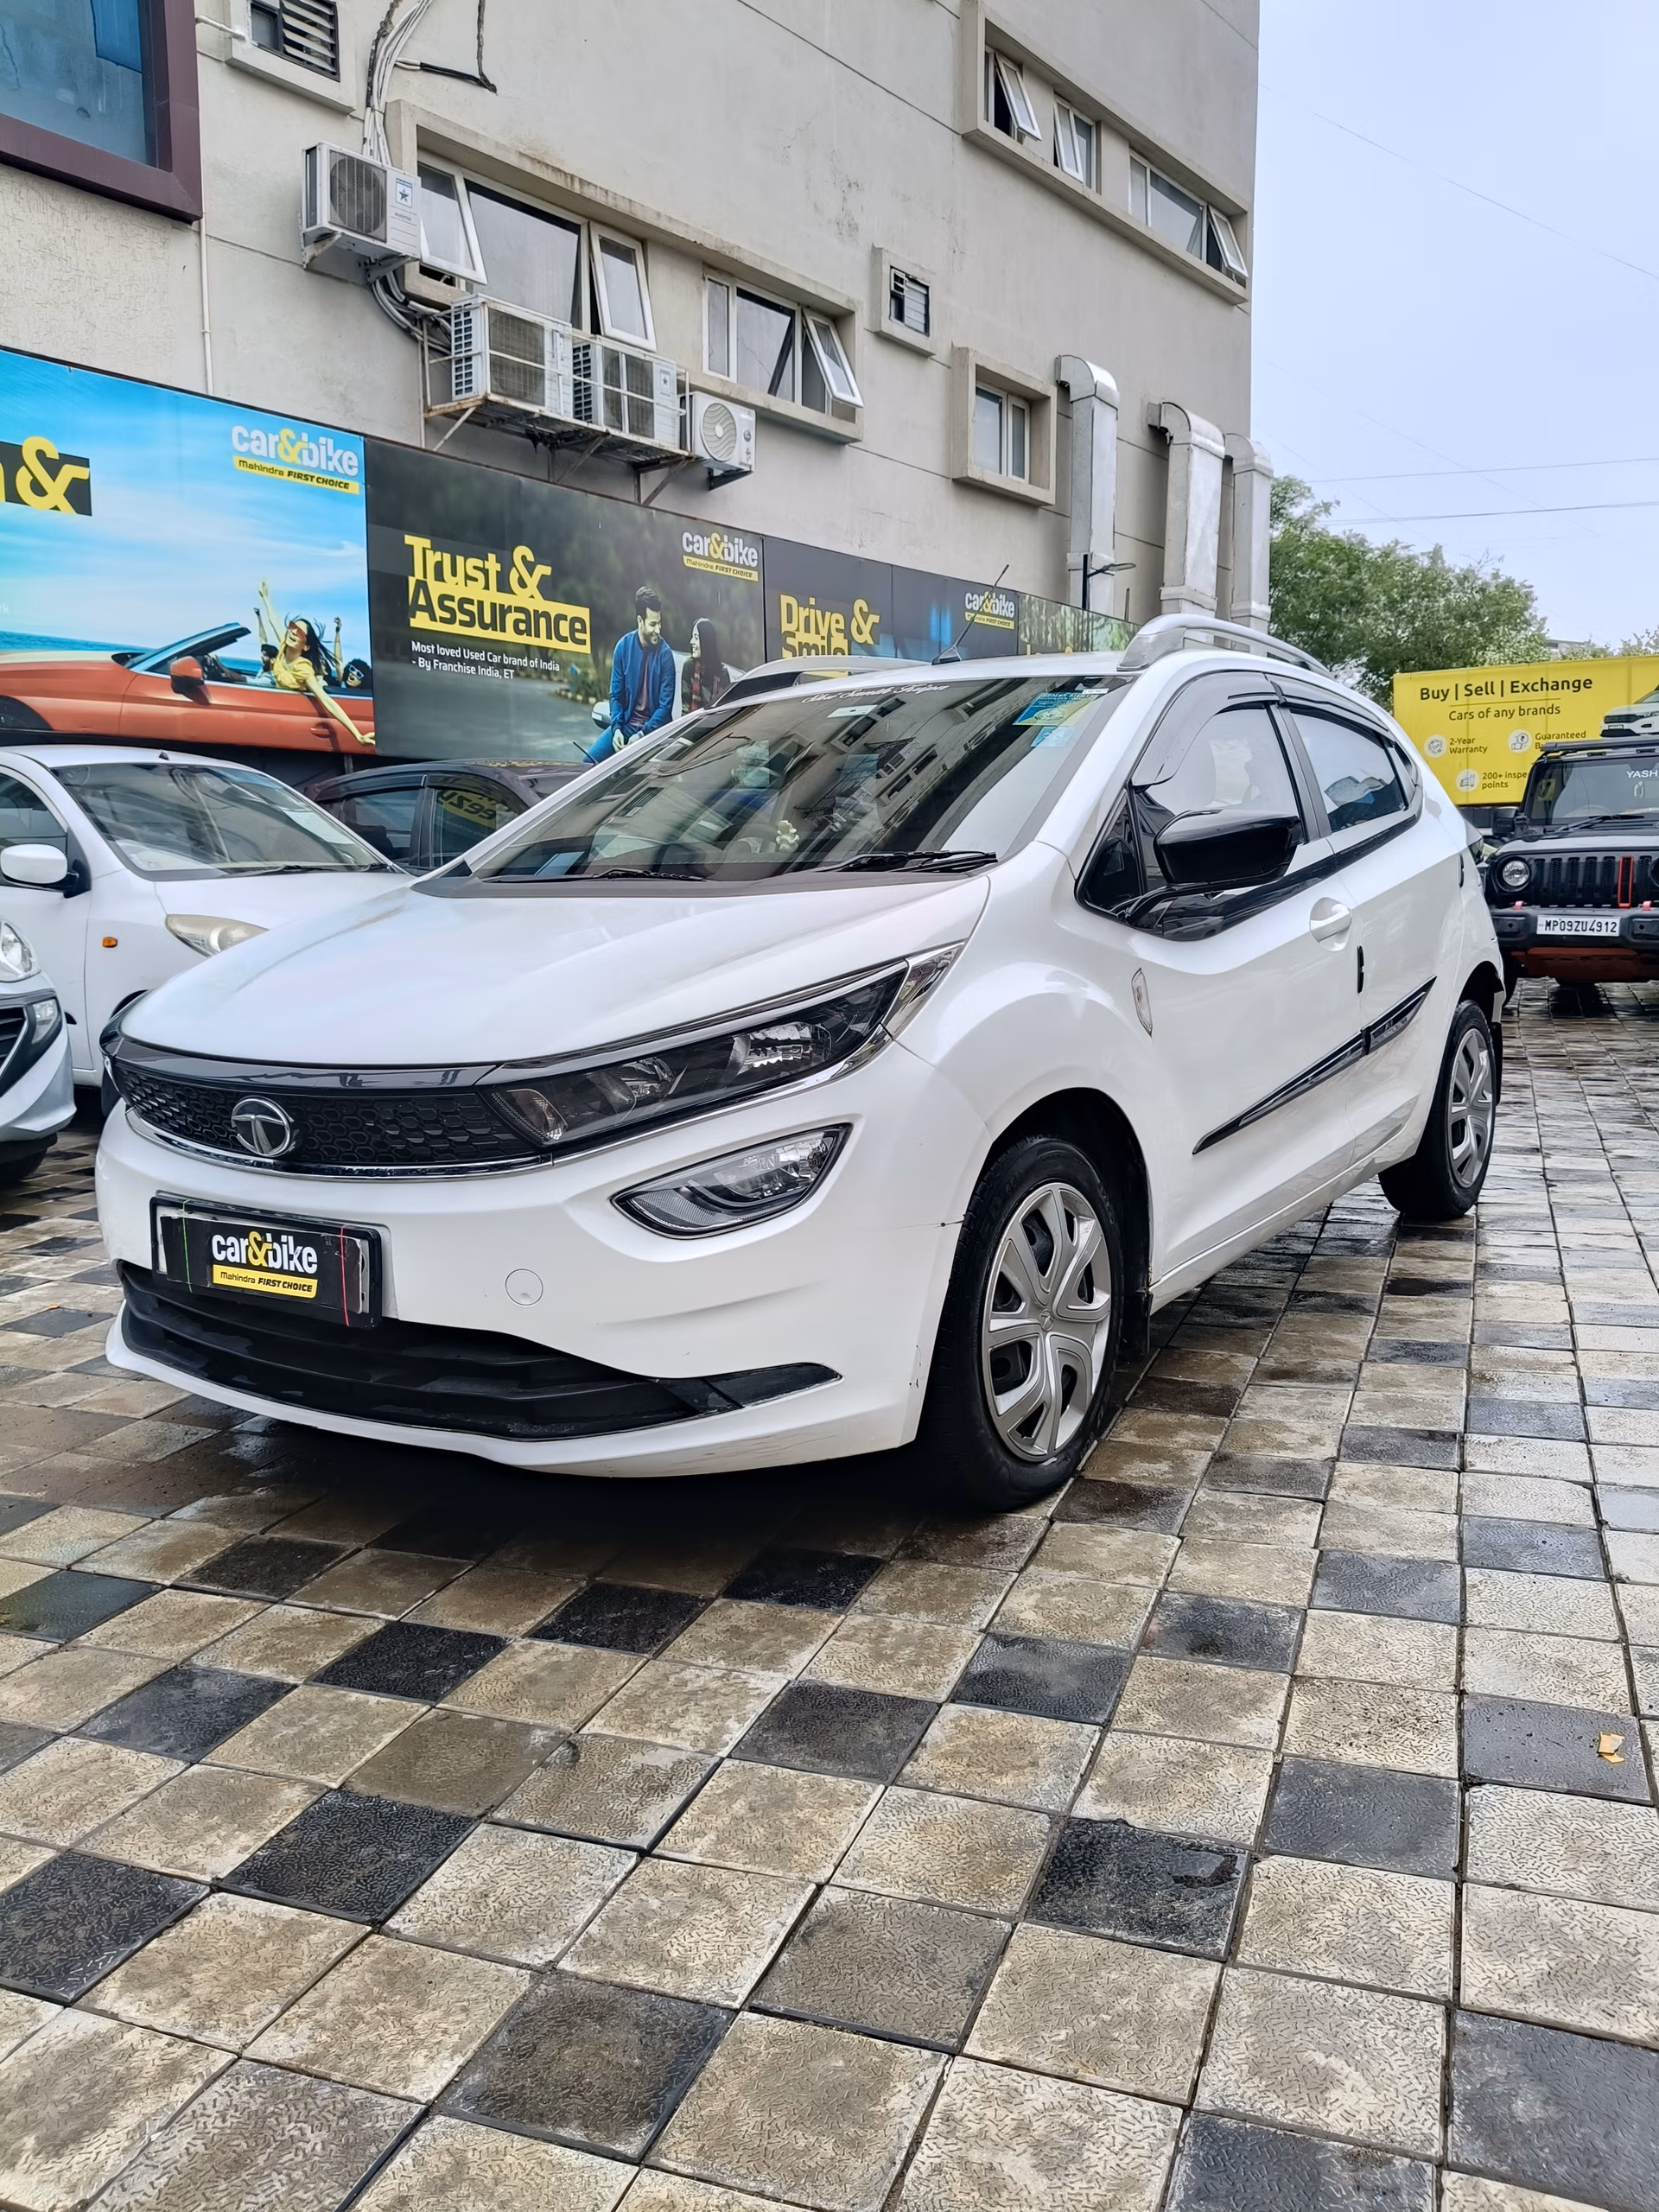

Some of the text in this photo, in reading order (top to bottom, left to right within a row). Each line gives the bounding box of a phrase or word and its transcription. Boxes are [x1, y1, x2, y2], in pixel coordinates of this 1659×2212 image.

[232, 425, 359, 476] car&bike
[16, 436, 90, 514] &
[238, 460, 350, 489] Mahindra FIRST CHOICE
[682, 532, 758, 567] car&bike
[404, 534, 552, 601] Trust &
[686, 558, 714, 569] Mahindra
[715, 565, 732, 574] FIRST
[409, 578, 587, 645] Assurance
[780, 594, 880, 645] Drive &
[411, 640, 560, 671] Most loved Used Car brand of India
[418, 658, 431, 671] By
[434, 659, 476, 674] Franchise
[478, 665, 501, 679] India,
[504, 669, 515, 679] ET
[1420, 688, 1450, 702] Buy
[1464, 681, 1495, 696] Sell
[1510, 677, 1592, 693] Exchange
[1448, 704, 1560, 721] Cars of any brands
[1535, 731, 1586, 741] Guaranteed
[1449, 746, 1488, 754] Warranty
[1626, 770, 1658, 779] YASH
[1544, 918, 1618, 933] MP09ZU4912
[212, 1230, 318, 1274] car&bike
[220, 1271, 313, 1293] Mahindra FIRST CHOICE
